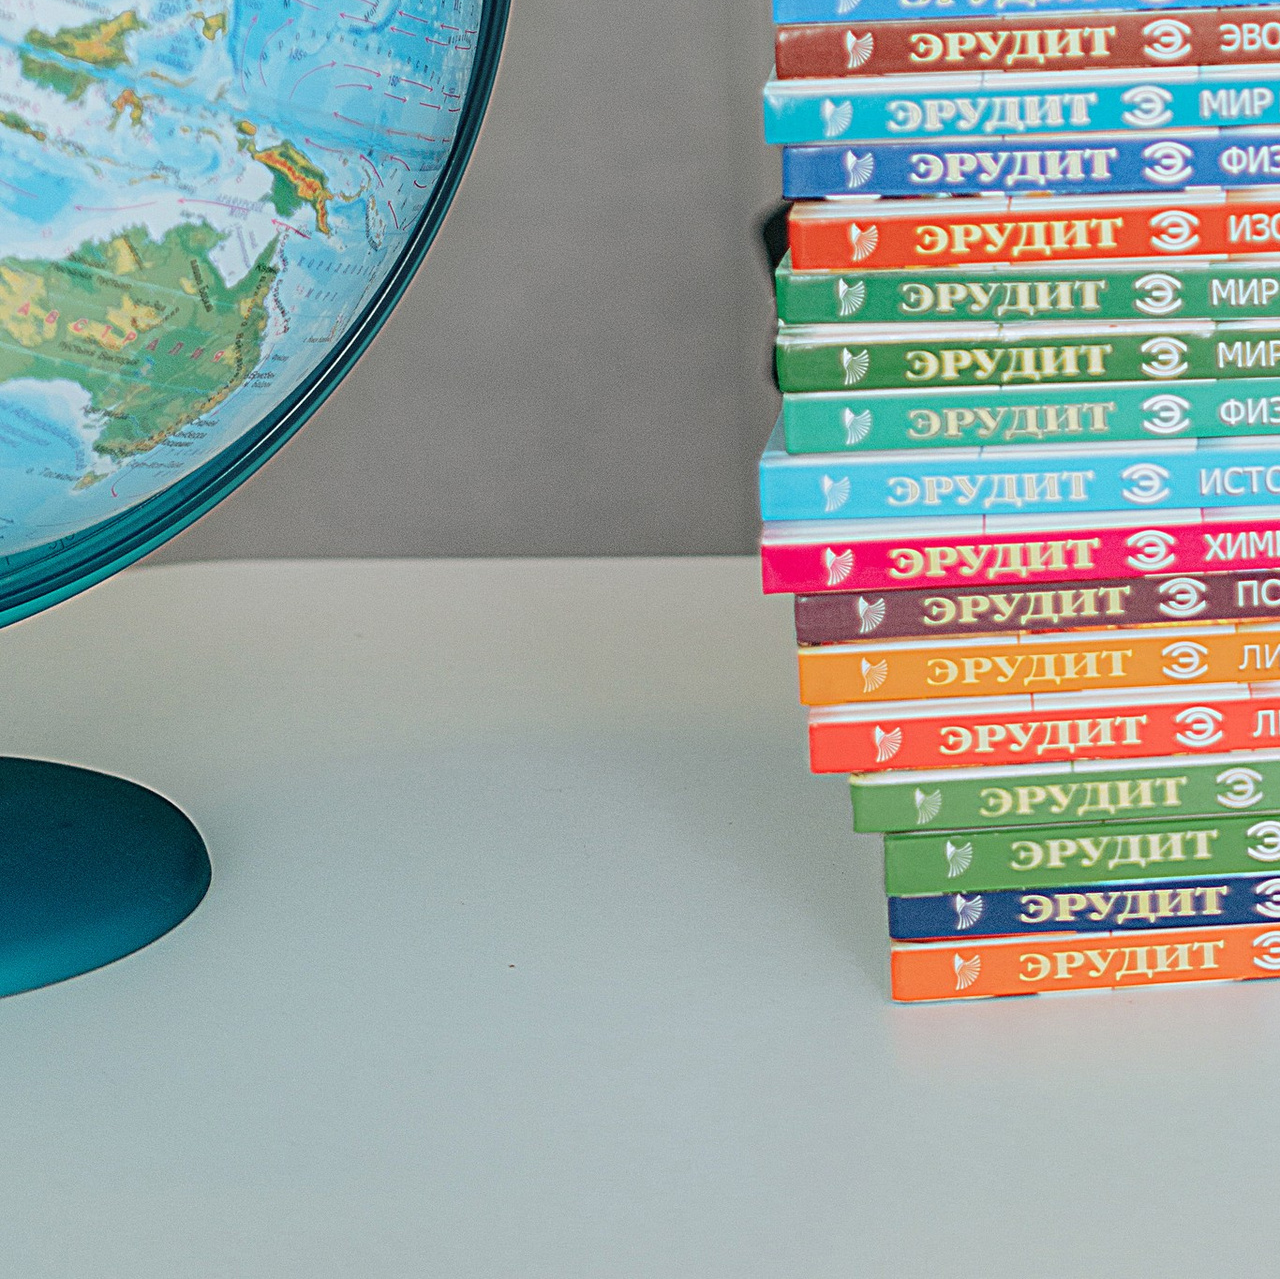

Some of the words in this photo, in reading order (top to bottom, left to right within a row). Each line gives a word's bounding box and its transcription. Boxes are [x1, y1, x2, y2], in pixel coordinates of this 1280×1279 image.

[910, 26, 1116, 63] ЭРУДИТ
[887, 91, 1097, 132] ЭРУДИТ
[1201, 88, 1275, 119] МИР
[909, 147, 1118, 186] ЭРУДИТ
[916, 217, 1123, 256] ЭРУДИТ
[902, 279, 1105, 315] ЭРУДИТ
[1210, 278, 1280, 306] МИР
[905, 344, 1113, 382] ЭРУДИТ
[908, 402, 1115, 440] ЭРУДИТ
[887, 470, 1094, 508] ЭРУДИТ
[889, 538, 1100, 578] ЭРУДИТ
[924, 586, 1130, 625] ЭРУДИТ
[926, 649, 1132, 686] ЭРУДИТ
[939, 714, 1147, 755] ЭРУДИТ
[979, 776, 1187, 816] ЭРУДИТ
[1011, 829, 1218, 871] ЭРУДИТ
[1020, 885, 1227, 924] ЭРУДИТ
[1019, 940, 1225, 981] ЭРУДИТ
